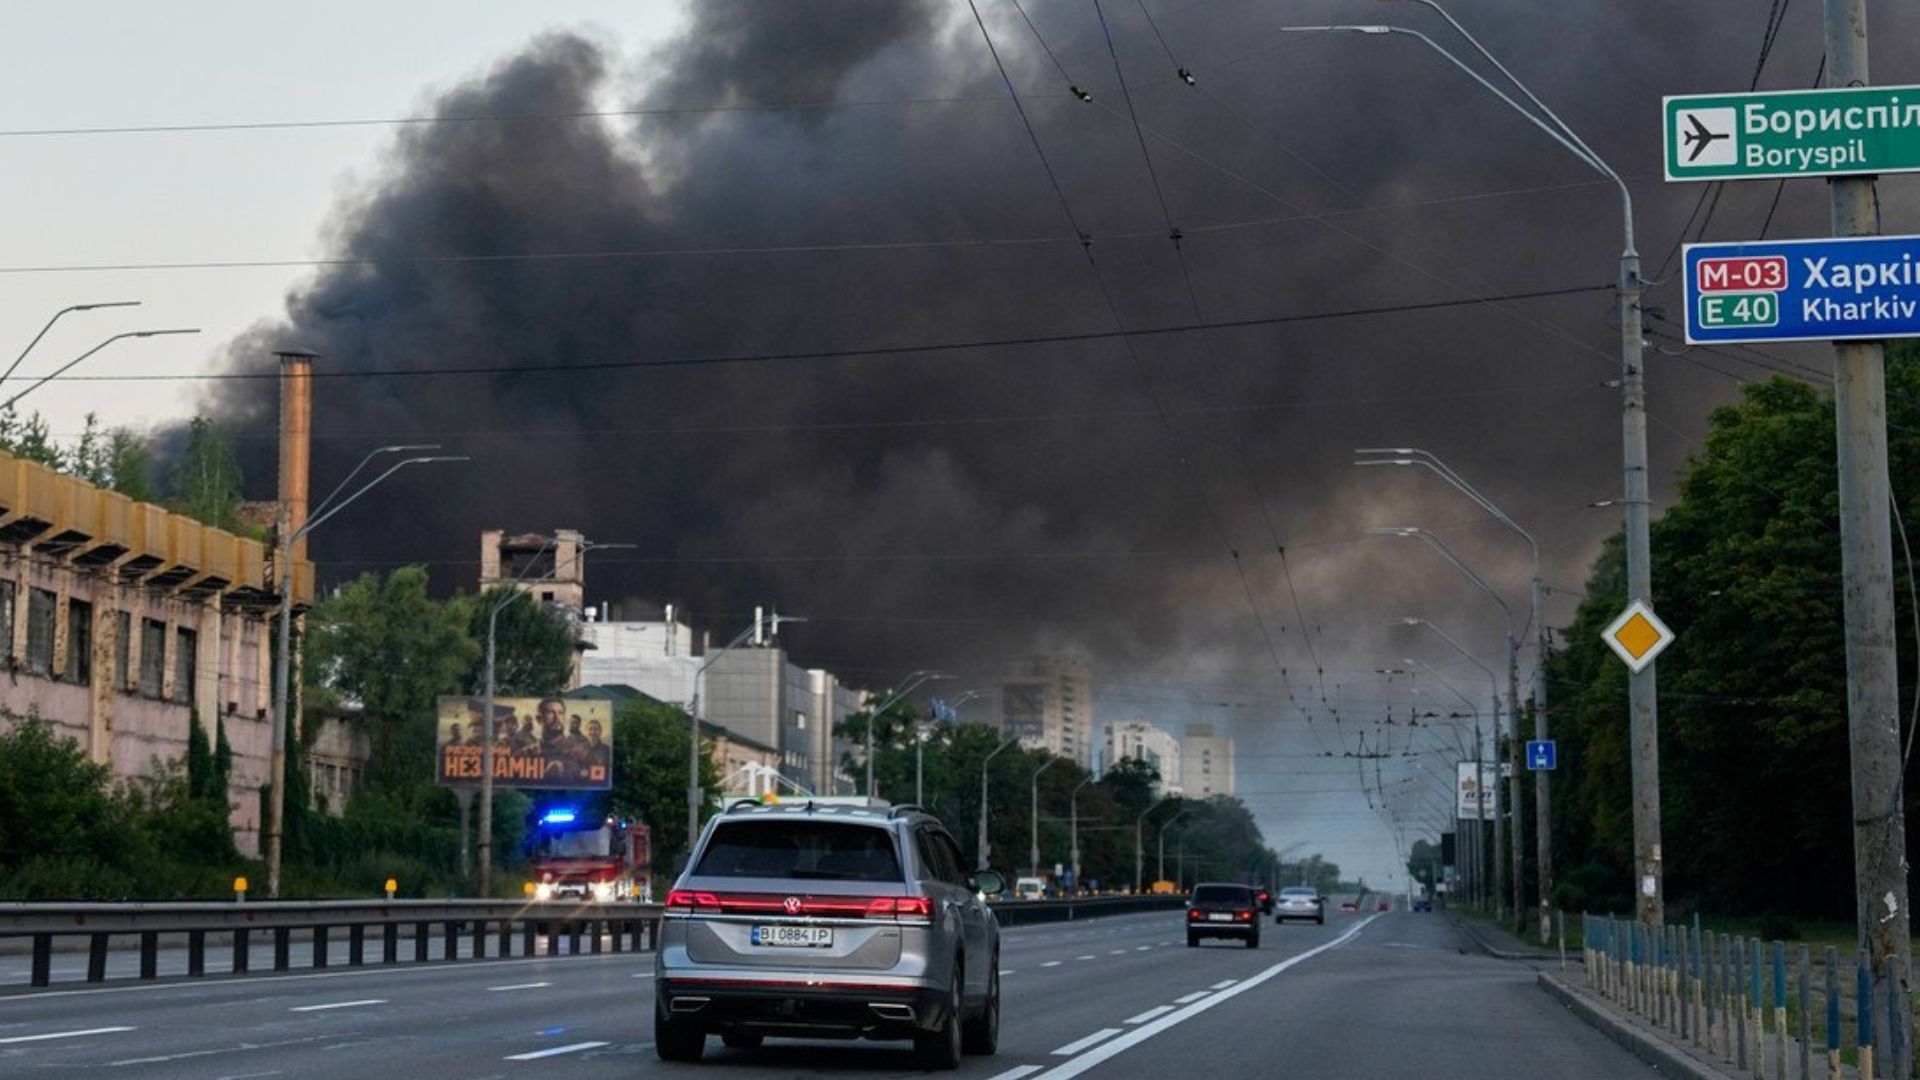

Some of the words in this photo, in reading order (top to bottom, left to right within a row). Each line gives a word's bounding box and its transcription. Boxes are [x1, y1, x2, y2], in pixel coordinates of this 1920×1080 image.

[1744, 97, 1920, 138] Бориспіл
[1745, 140, 1866, 170] Boryspil
[1703, 261, 1782, 288] M-03
[1732, 297, 1770, 322] 40
[1803, 295, 1916, 322] Kharkiv
